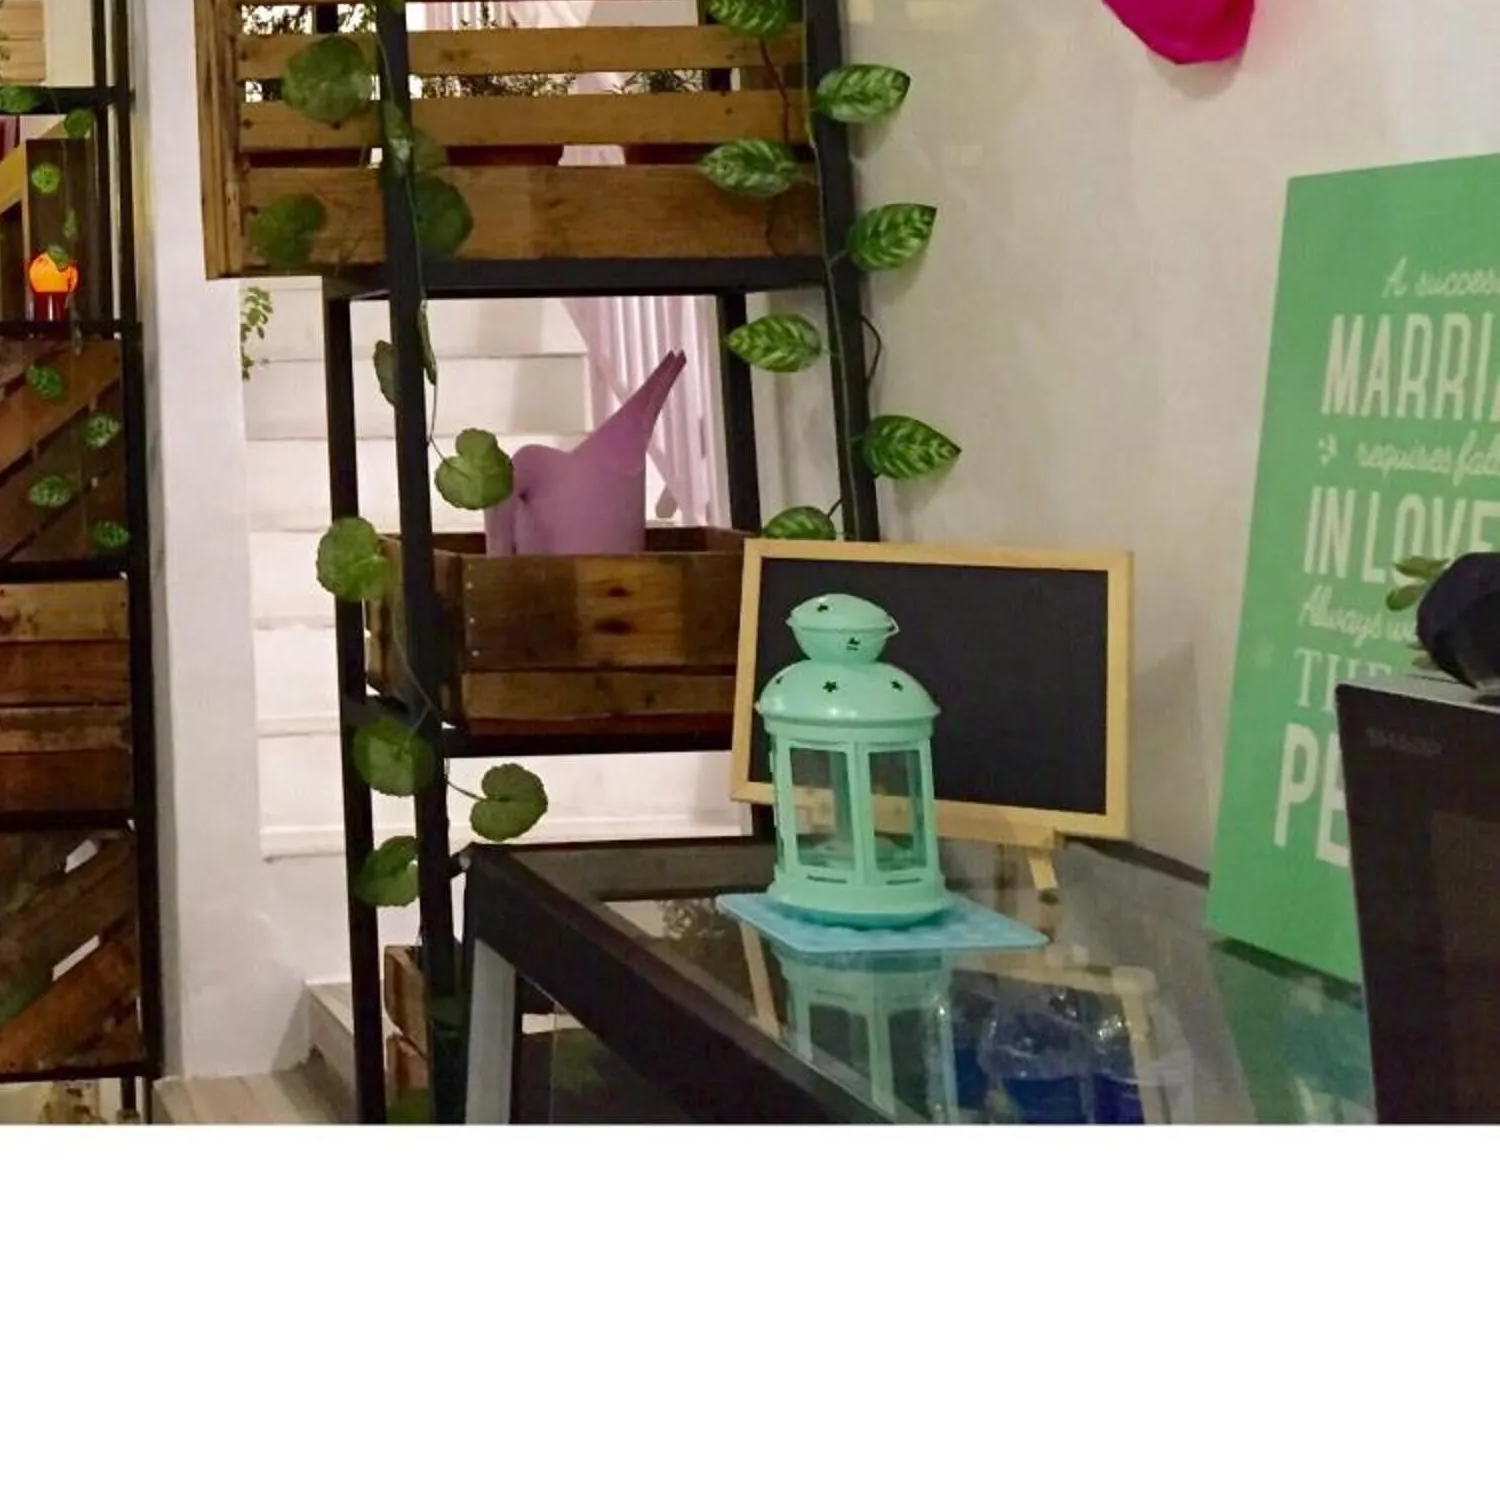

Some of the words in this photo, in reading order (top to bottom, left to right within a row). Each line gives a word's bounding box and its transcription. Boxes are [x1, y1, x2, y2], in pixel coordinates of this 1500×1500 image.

[1380, 255, 1408, 298] A
[1303, 486, 1356, 579] IN
[1297, 583, 1382, 648] Always
